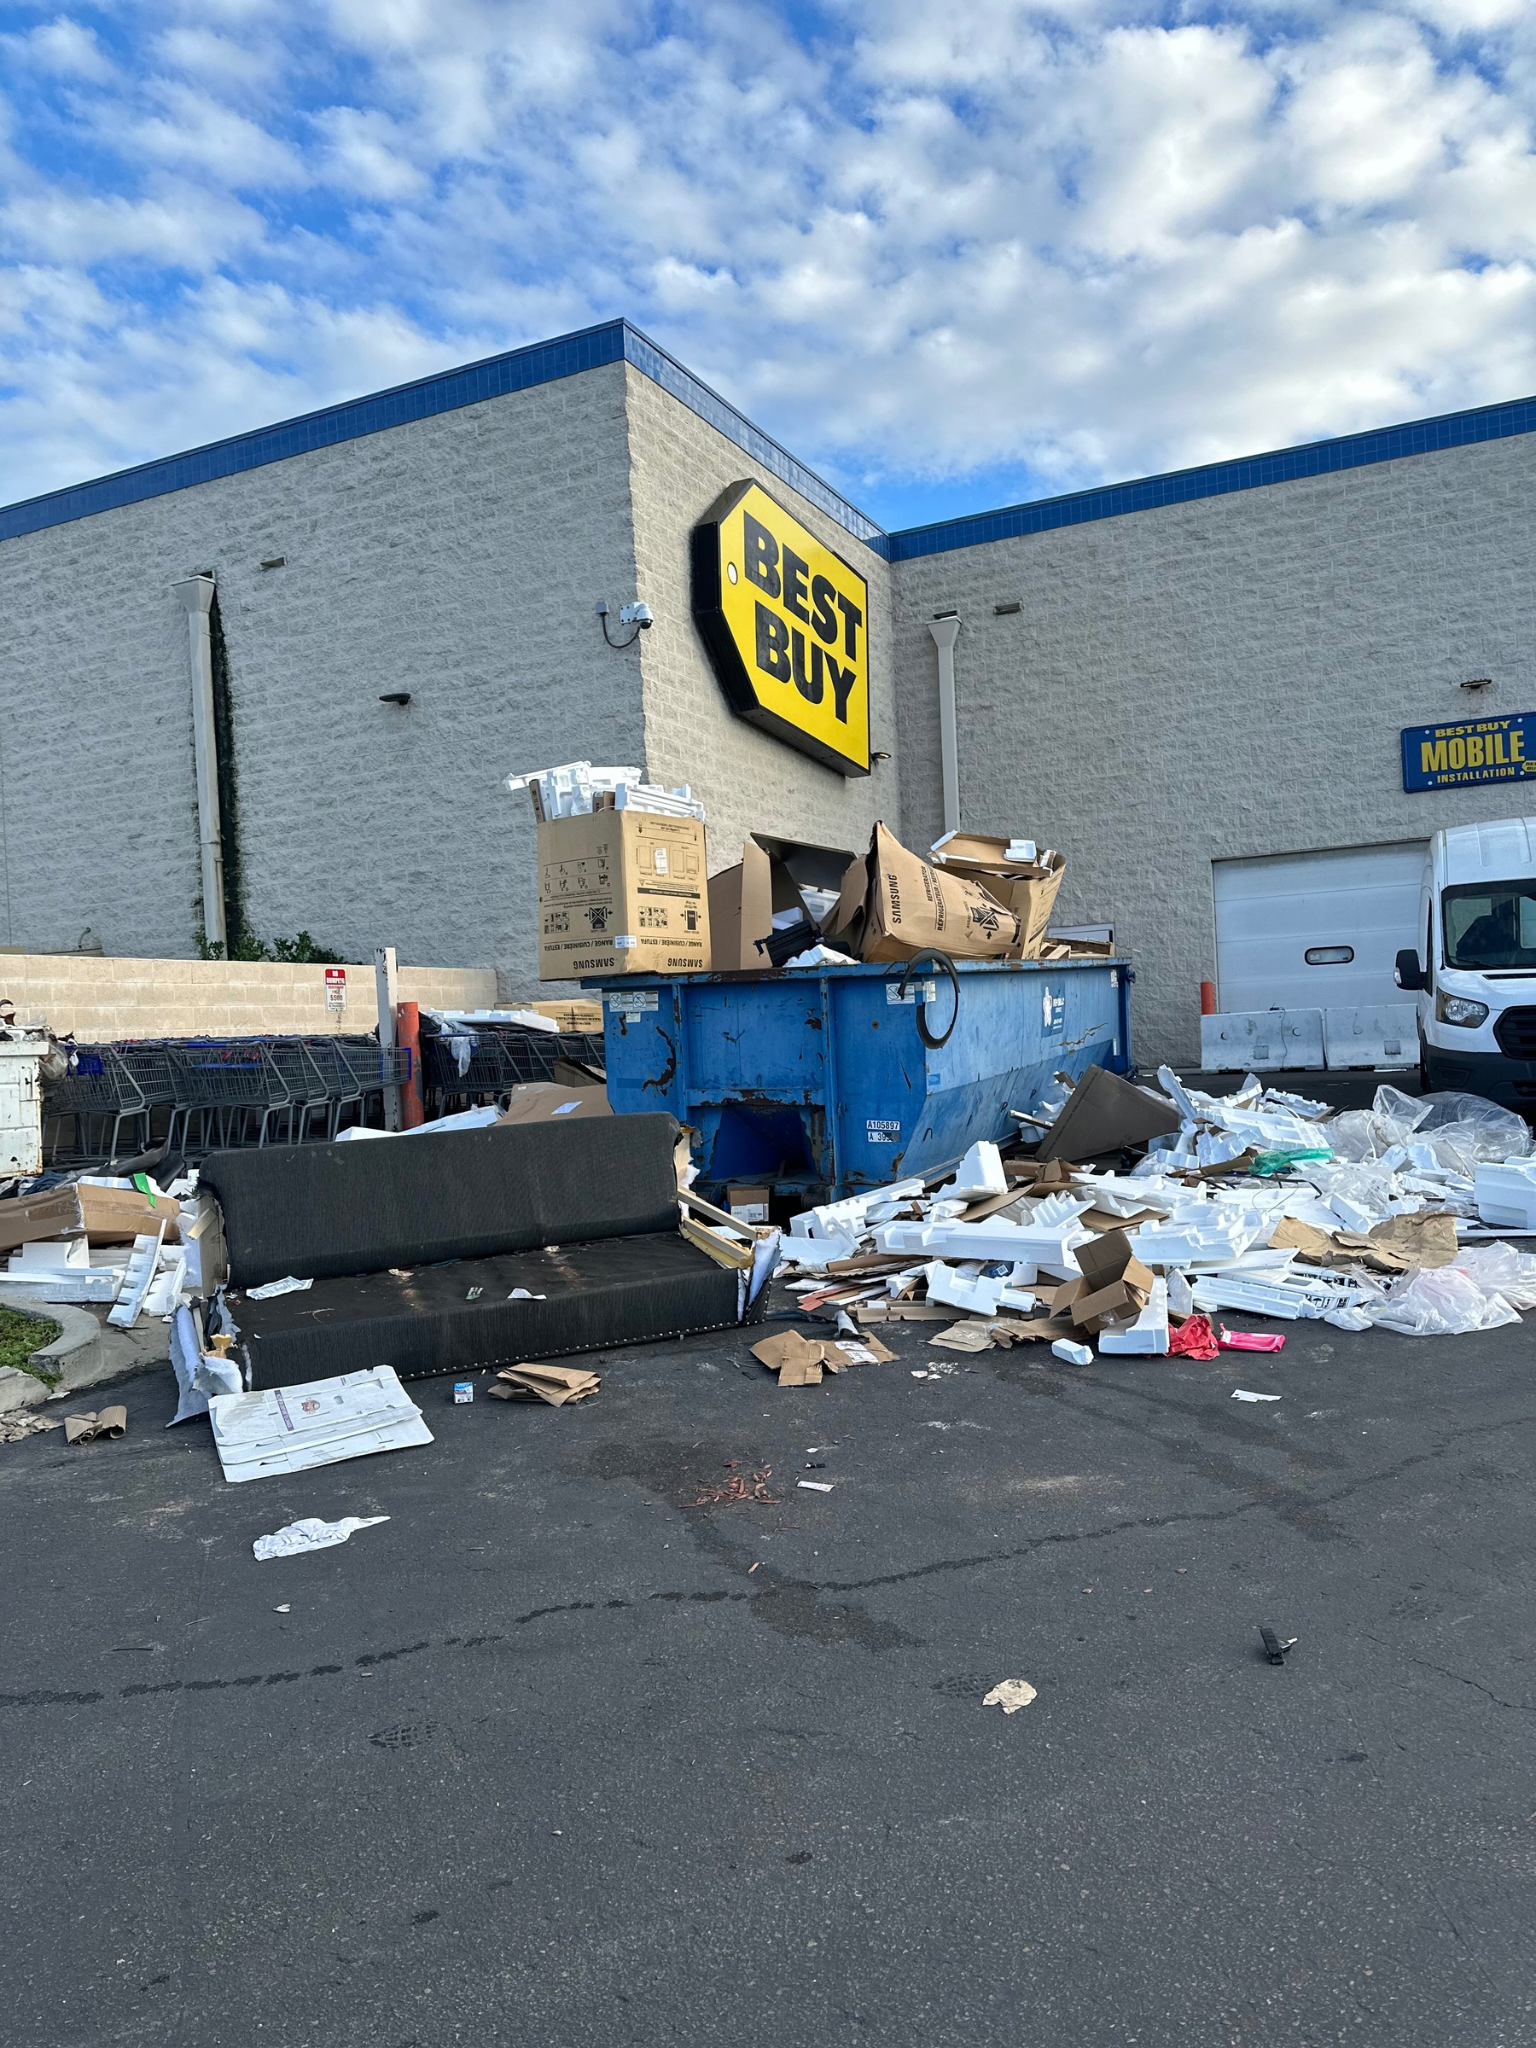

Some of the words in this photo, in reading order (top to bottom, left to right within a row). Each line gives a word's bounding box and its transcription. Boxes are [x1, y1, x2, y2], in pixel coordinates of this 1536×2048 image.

[744, 509, 863, 662] BEST
[755, 600, 857, 725] BUY
[1435, 725, 1475, 738] BEST
[1476, 720, 1512, 732] BUY
[1421, 730, 1525, 773] MOBILE
[1437, 767, 1515, 784] INSTALLATION
[921, 865, 933, 902] REFRIGERATOR
[888, 874, 902, 924] SAMSUNG
[573, 957, 615, 970] SAMSUNG
[667, 958, 703, 968] SAMSUNG
[867, 1120, 899, 1130] A105897
